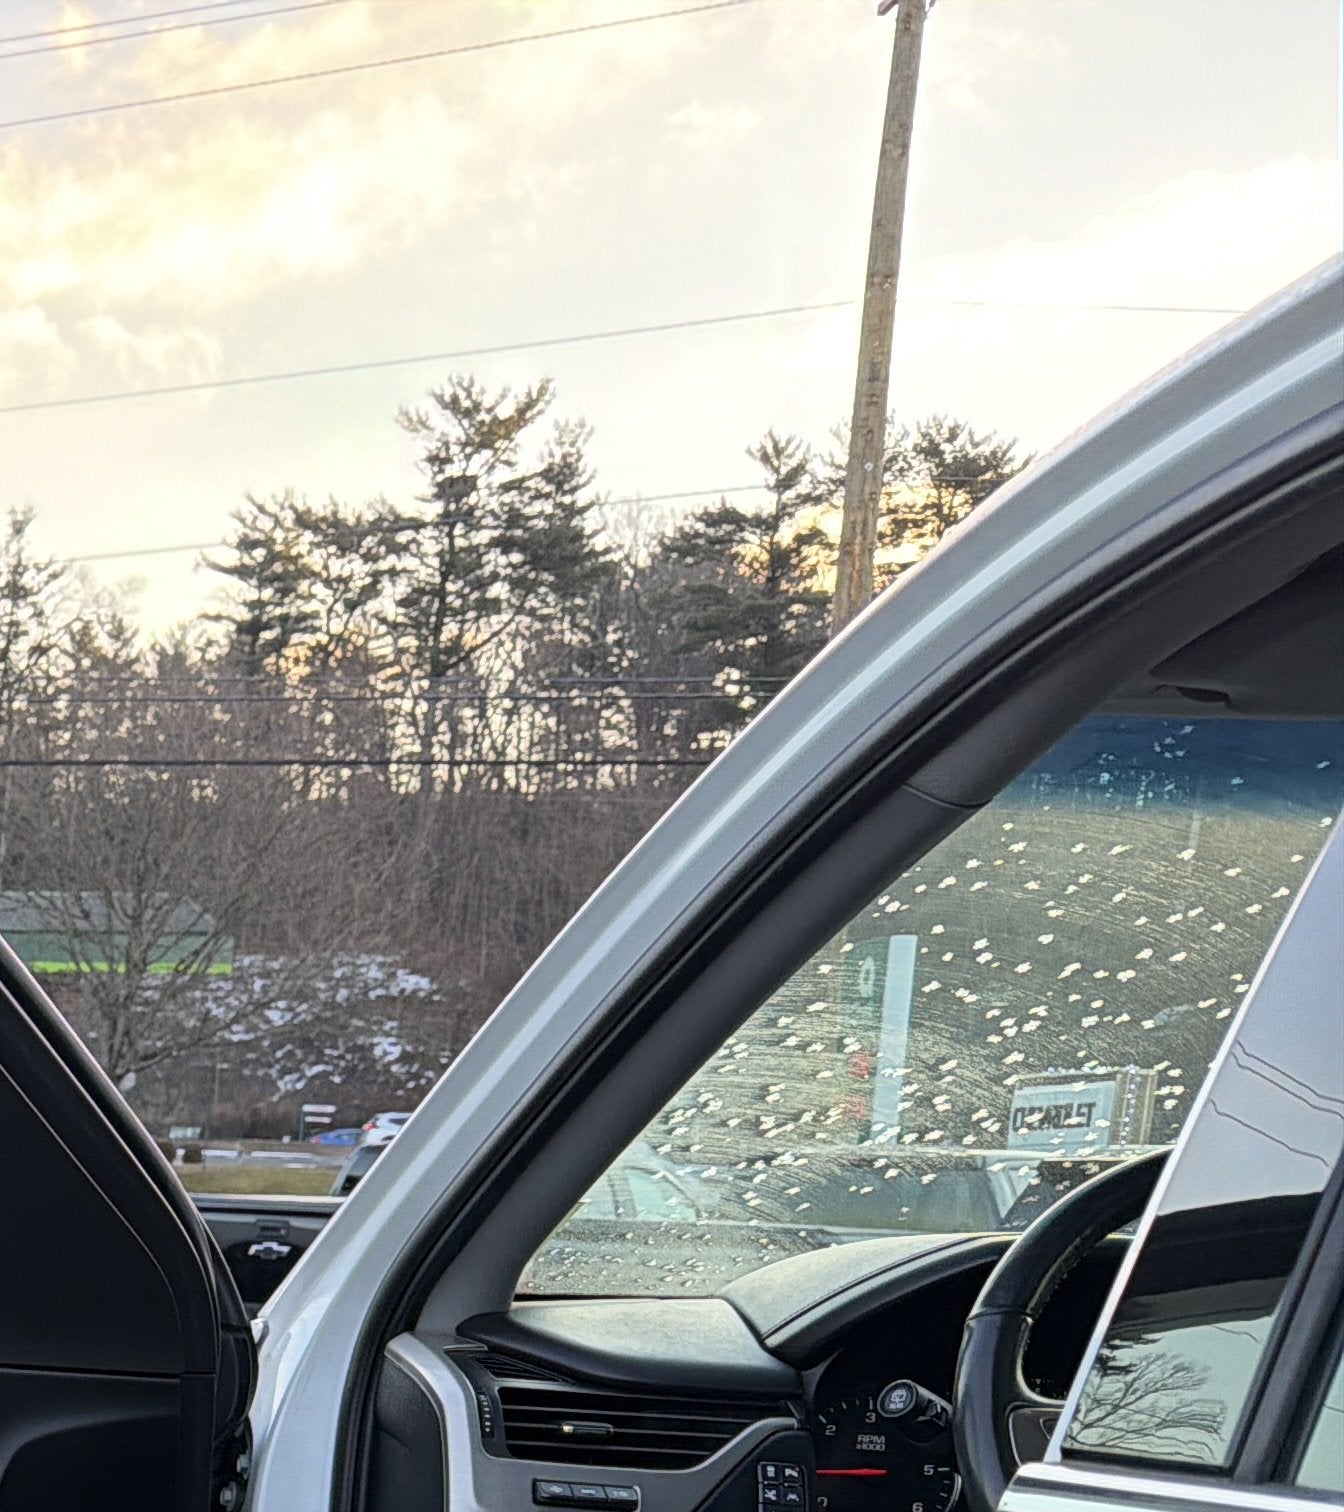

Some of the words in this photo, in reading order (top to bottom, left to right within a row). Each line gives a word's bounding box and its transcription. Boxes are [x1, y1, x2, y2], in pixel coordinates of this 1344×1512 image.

[865, 1412, 877, 1424] 3
[824, 1425, 837, 1436] 2
[856, 1434, 886, 1444] RPM
[923, 1464, 935, 1476] 5
